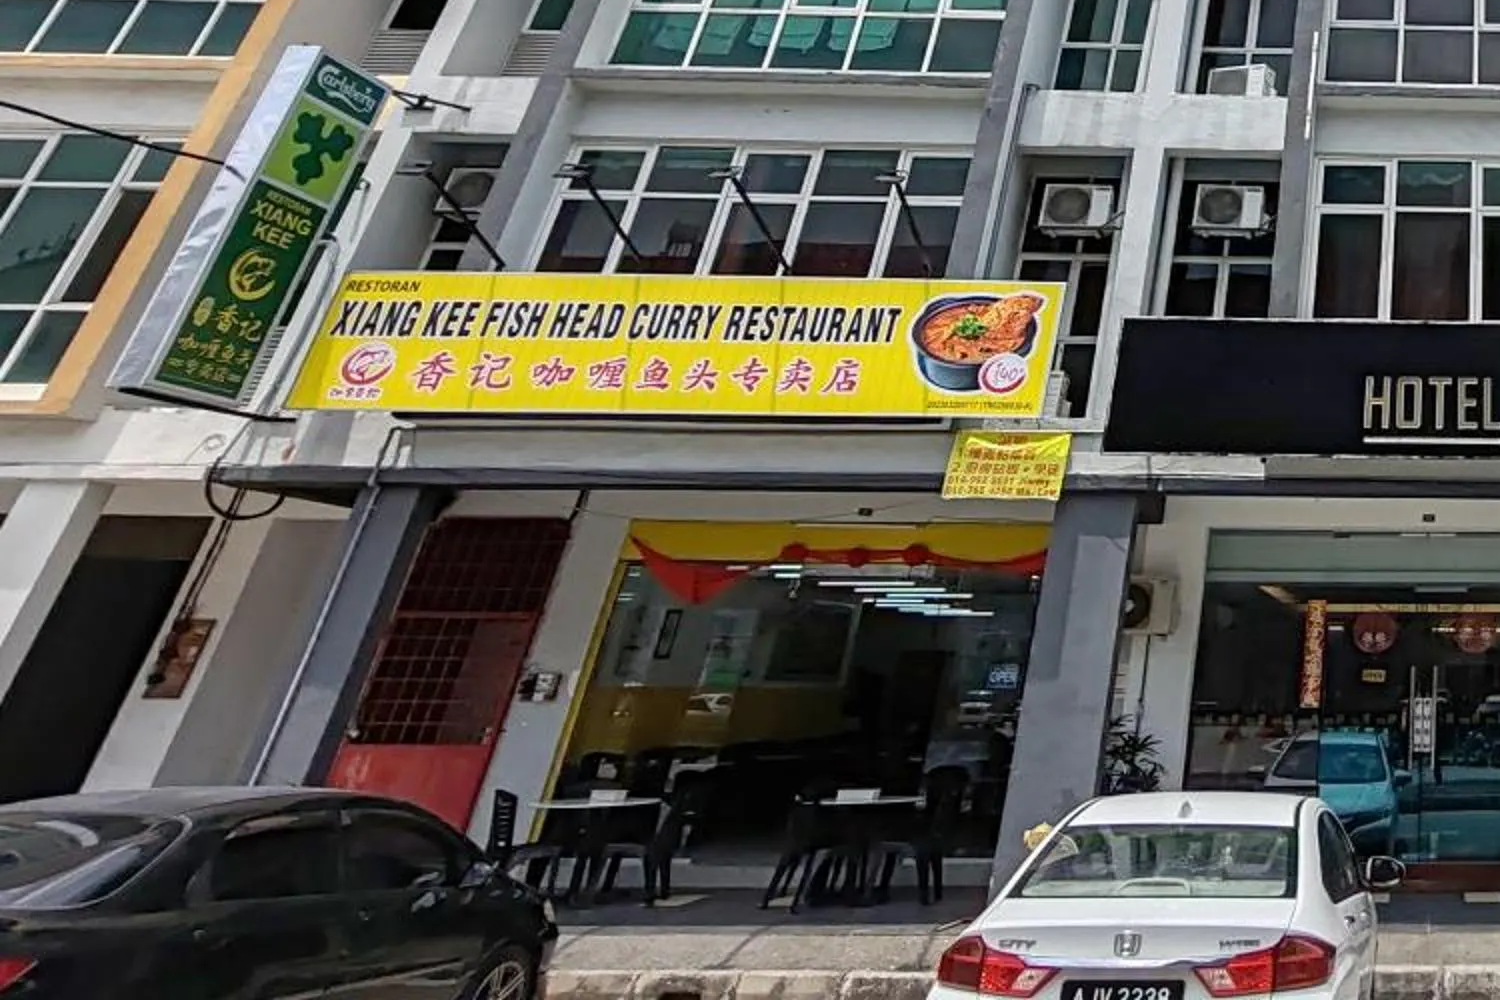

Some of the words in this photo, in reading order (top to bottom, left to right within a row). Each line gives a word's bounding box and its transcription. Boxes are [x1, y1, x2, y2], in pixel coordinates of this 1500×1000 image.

[317, 64, 377, 113] Carlsberg
[251, 200, 313, 236] XIANG
[252, 221, 295, 249] KEE
[346, 280, 420, 293] RESTORAN
[213, 303, 262, 342] 香记
[330, 300, 421, 336] XIANG
[421, 301, 481, 337] KEE
[480, 301, 548, 337] FISH
[547, 302, 626, 339] HEAD
[628, 303, 722, 340] CURRY
[723, 305, 903, 342] RESTAURANT
[411, 351, 862, 394] 香记咖喱鱼头专卖店
